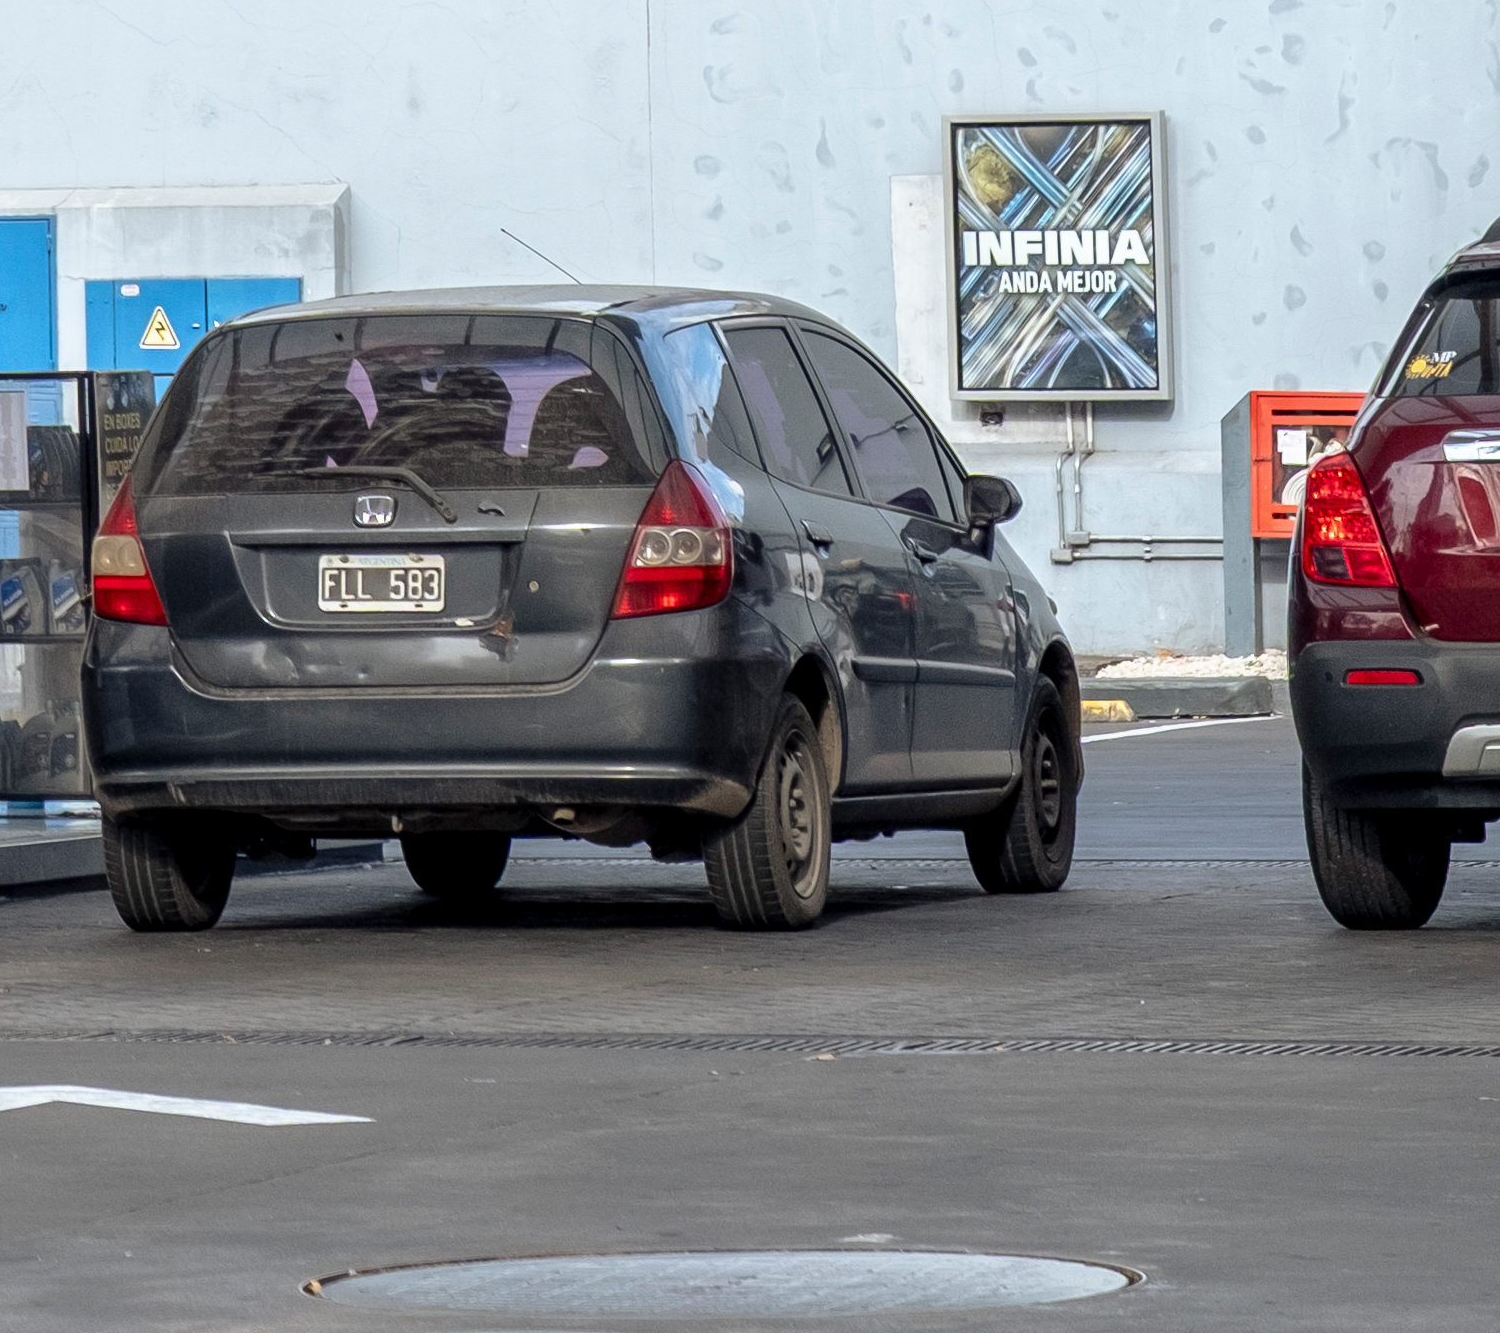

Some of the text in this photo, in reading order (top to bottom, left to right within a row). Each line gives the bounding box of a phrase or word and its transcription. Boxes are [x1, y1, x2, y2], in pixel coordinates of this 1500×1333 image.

[963, 229, 1150, 266] INFINIA
[999, 270, 1117, 293] ANDA MEJOR
[323, 568, 440, 601] FLL 583
